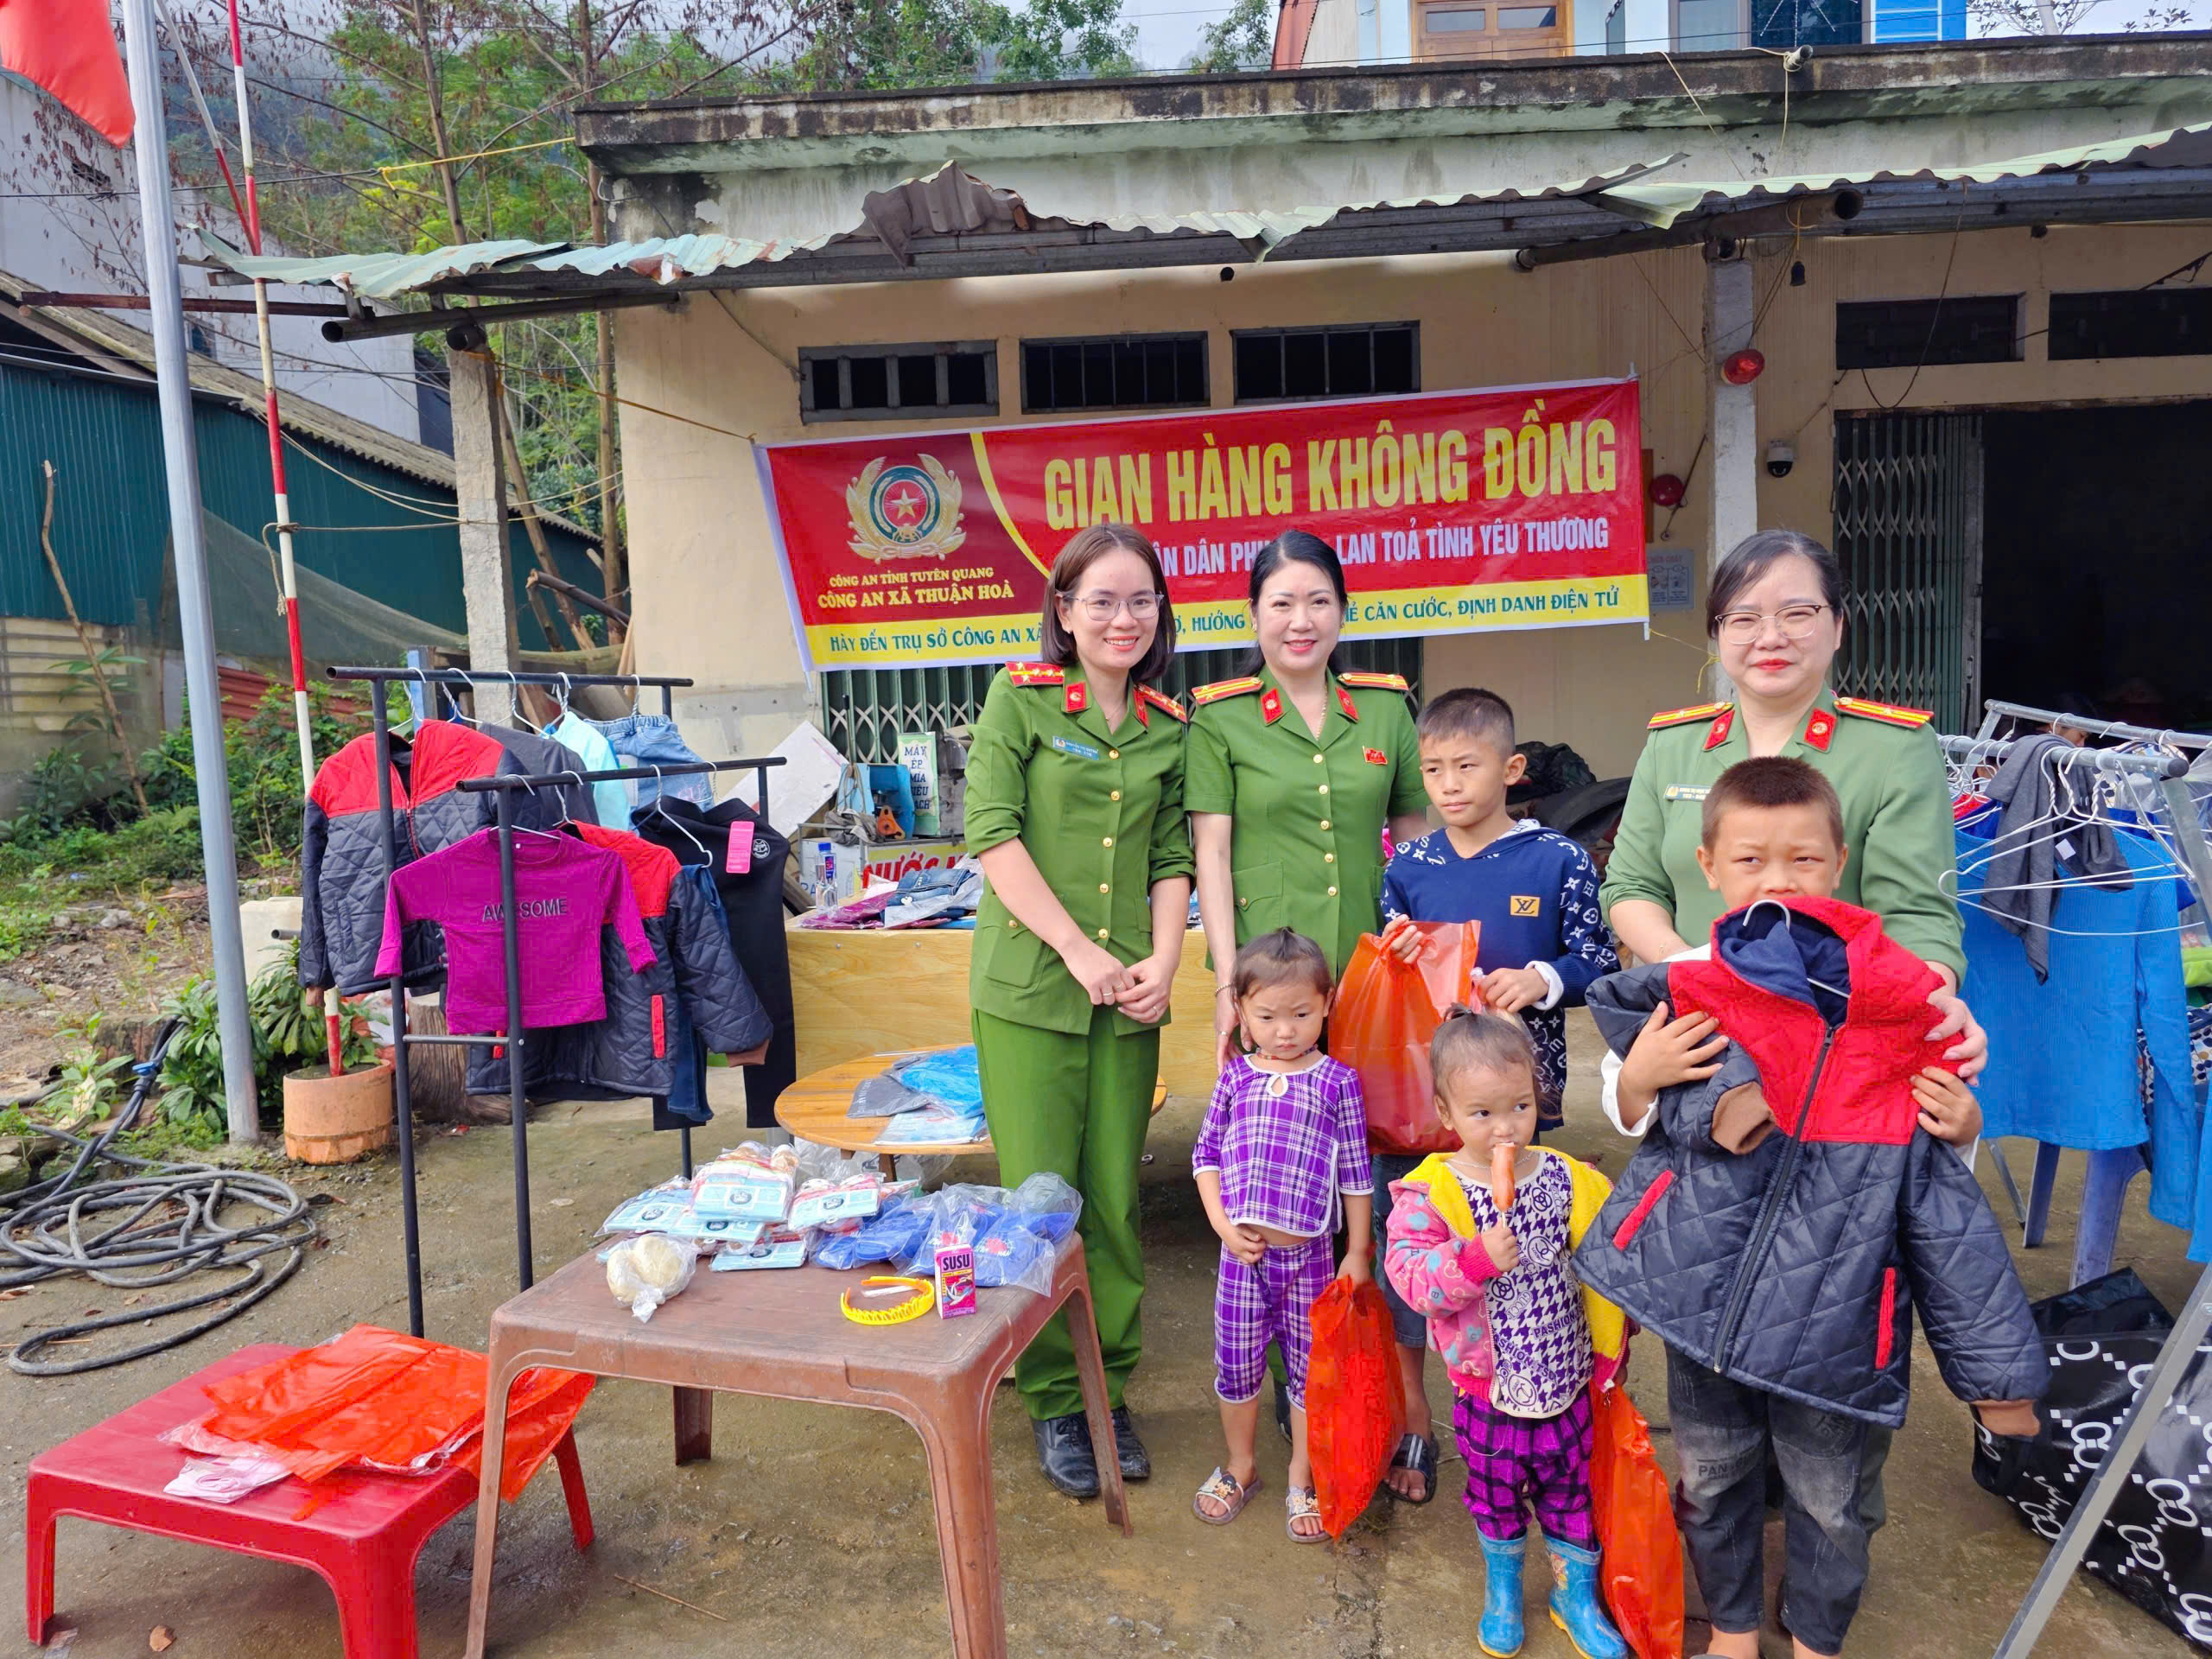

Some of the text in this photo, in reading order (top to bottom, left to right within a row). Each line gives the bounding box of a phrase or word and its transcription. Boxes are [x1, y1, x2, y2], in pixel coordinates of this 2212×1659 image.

[1044, 398, 1617, 531] GIAN HÀNG KHÔNG ĐỒNG
[1184, 537, 1225, 575] DÂN
[1336, 532, 1376, 565] LAN
[1382, 517, 1421, 562] TOẢ
[1427, 521, 1473, 560] TÌNH
[1479, 518, 1519, 556] YÊU
[1524, 516, 1609, 553] THƯƠNG
[829, 574, 859, 588] CÔNG
[861, 575, 879, 586] AN
[910, 568, 950, 583] TUYÊN
[952, 567, 994, 582] QUANG
[817, 580, 1014, 608] CÔNG AN XÃ THUẬN HOÀ
[860, 628, 887, 651] ĐẾN
[892, 634, 922, 654] TRỤ
[926, 627, 948, 648] SỞ
[952, 626, 995, 647] CÔNG
[1001, 628, 1020, 644] AN
[1192, 610, 1245, 632] HƯỚNG
[1364, 601, 1397, 621] CĂN
[1402, 596, 1452, 618] CƯỚC,
[1458, 597, 1497, 620] ĐỊNH
[1502, 594, 1546, 613] DANH
[1551, 588, 1588, 614] ĐIỆN
[1594, 585, 1619, 607] TỬ
[482, 898, 568, 922] AWSOME
[943, 1253, 970, 1271] SUSU
